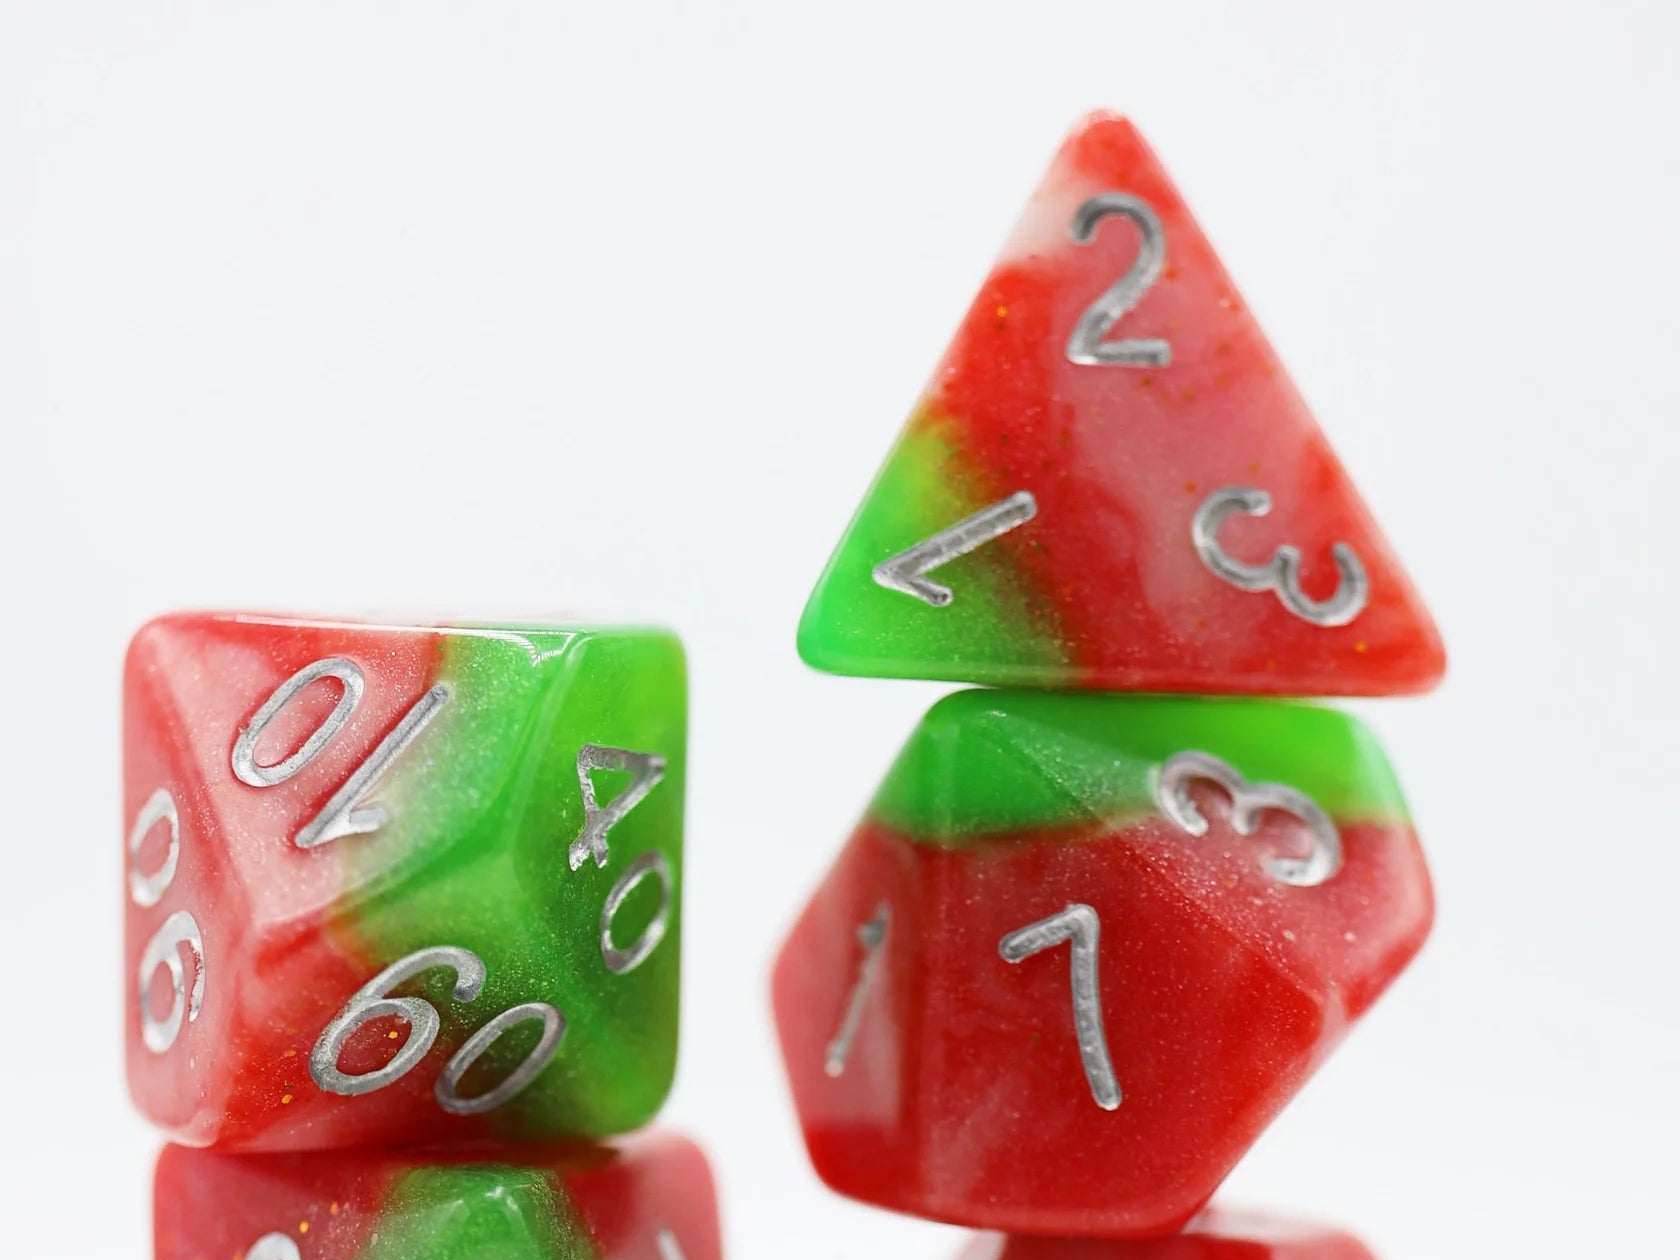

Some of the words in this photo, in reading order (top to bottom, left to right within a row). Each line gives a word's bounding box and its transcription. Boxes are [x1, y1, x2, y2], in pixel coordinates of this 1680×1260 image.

[1067, 192, 1172, 367] 2
[871, 491, 1038, 608] 1
[1192, 485, 1369, 627] 3
[231, 657, 450, 849] 10
[1153, 749, 1343, 888] 3
[568, 743, 673, 976] 40
[999, 903, 1122, 1112] 7
